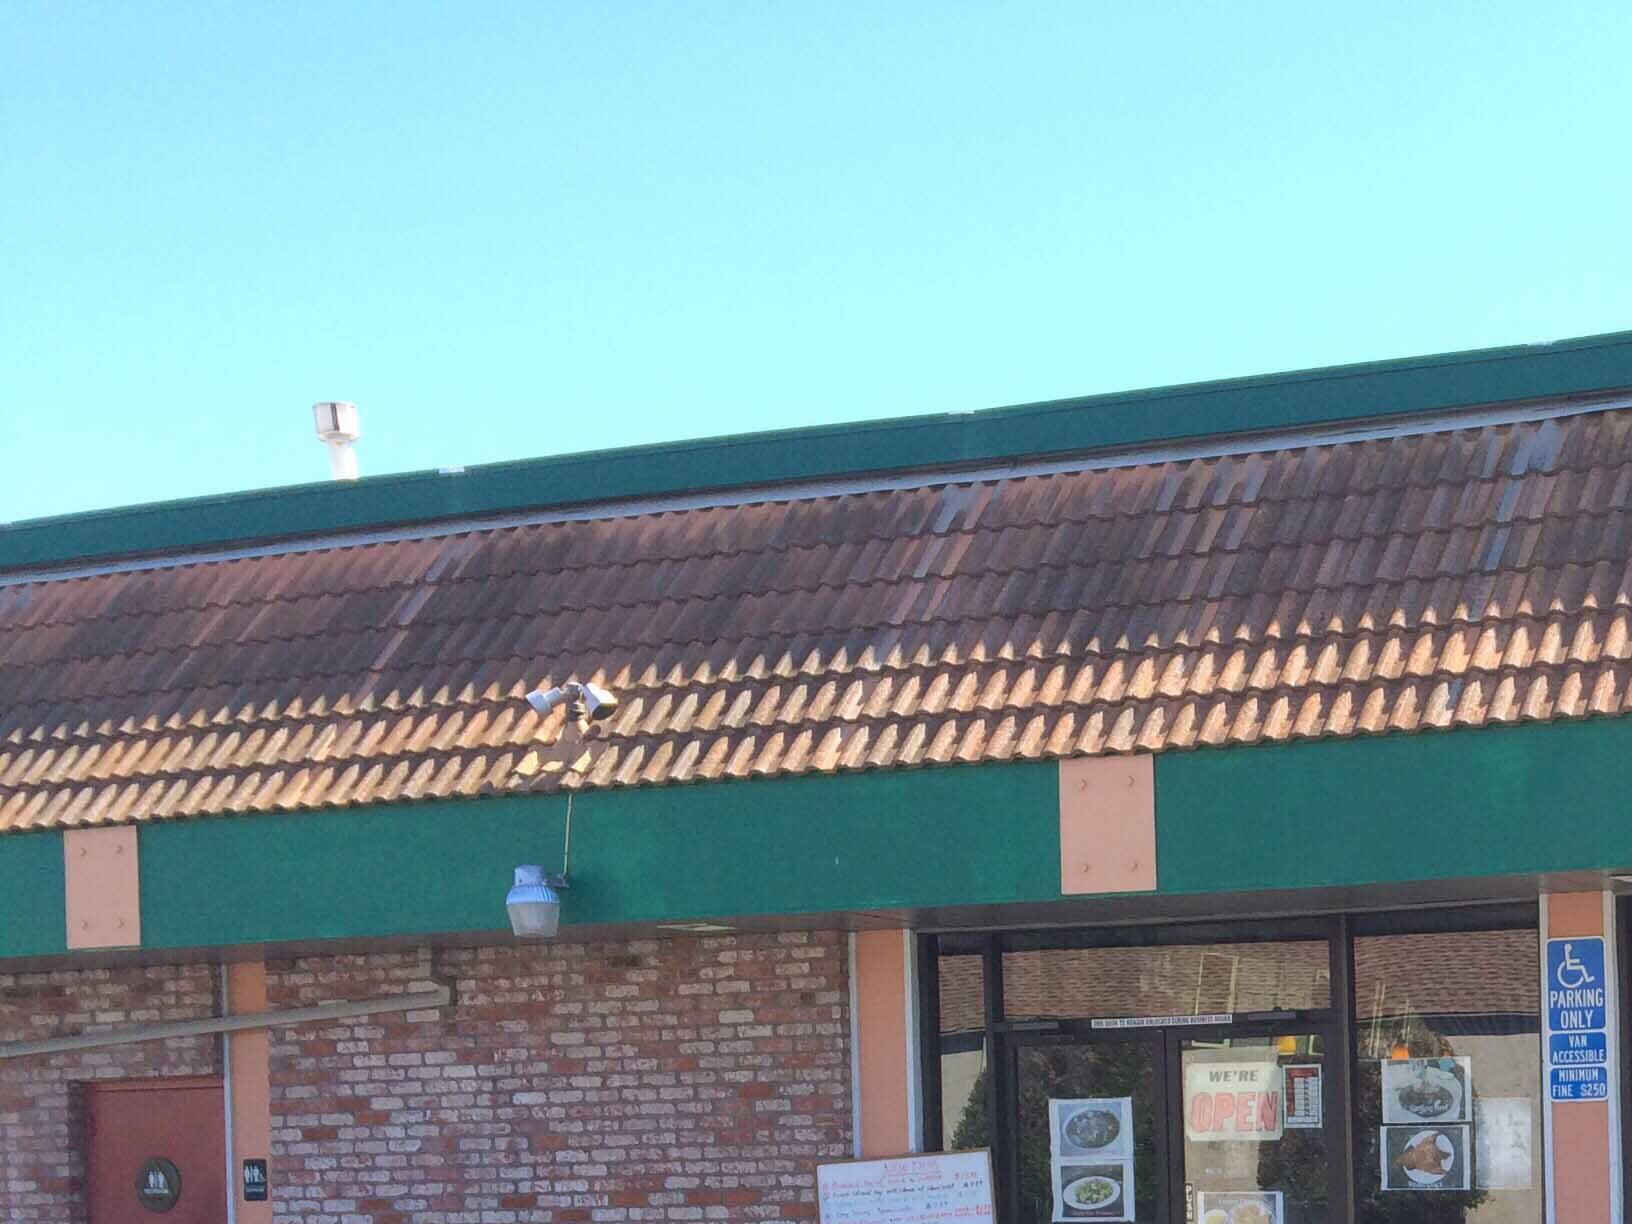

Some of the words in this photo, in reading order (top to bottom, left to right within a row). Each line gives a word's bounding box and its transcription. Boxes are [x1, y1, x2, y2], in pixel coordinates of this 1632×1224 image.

[1550, 988, 1604, 1009] PARKING
[1560, 1009, 1594, 1029] ONLY
[1568, 1035, 1588, 1048] VAN
[1552, 1049, 1605, 1064] ACCESSIBLE
[1209, 1070, 1259, 1083] WE'RE
[1558, 1068, 1599, 1082] MINIMUM
[1552, 1084, 1573, 1097] FINE
[1191, 1090, 1279, 1133] OPEN
[1184, 1184, 1194, 1221] PUSH
